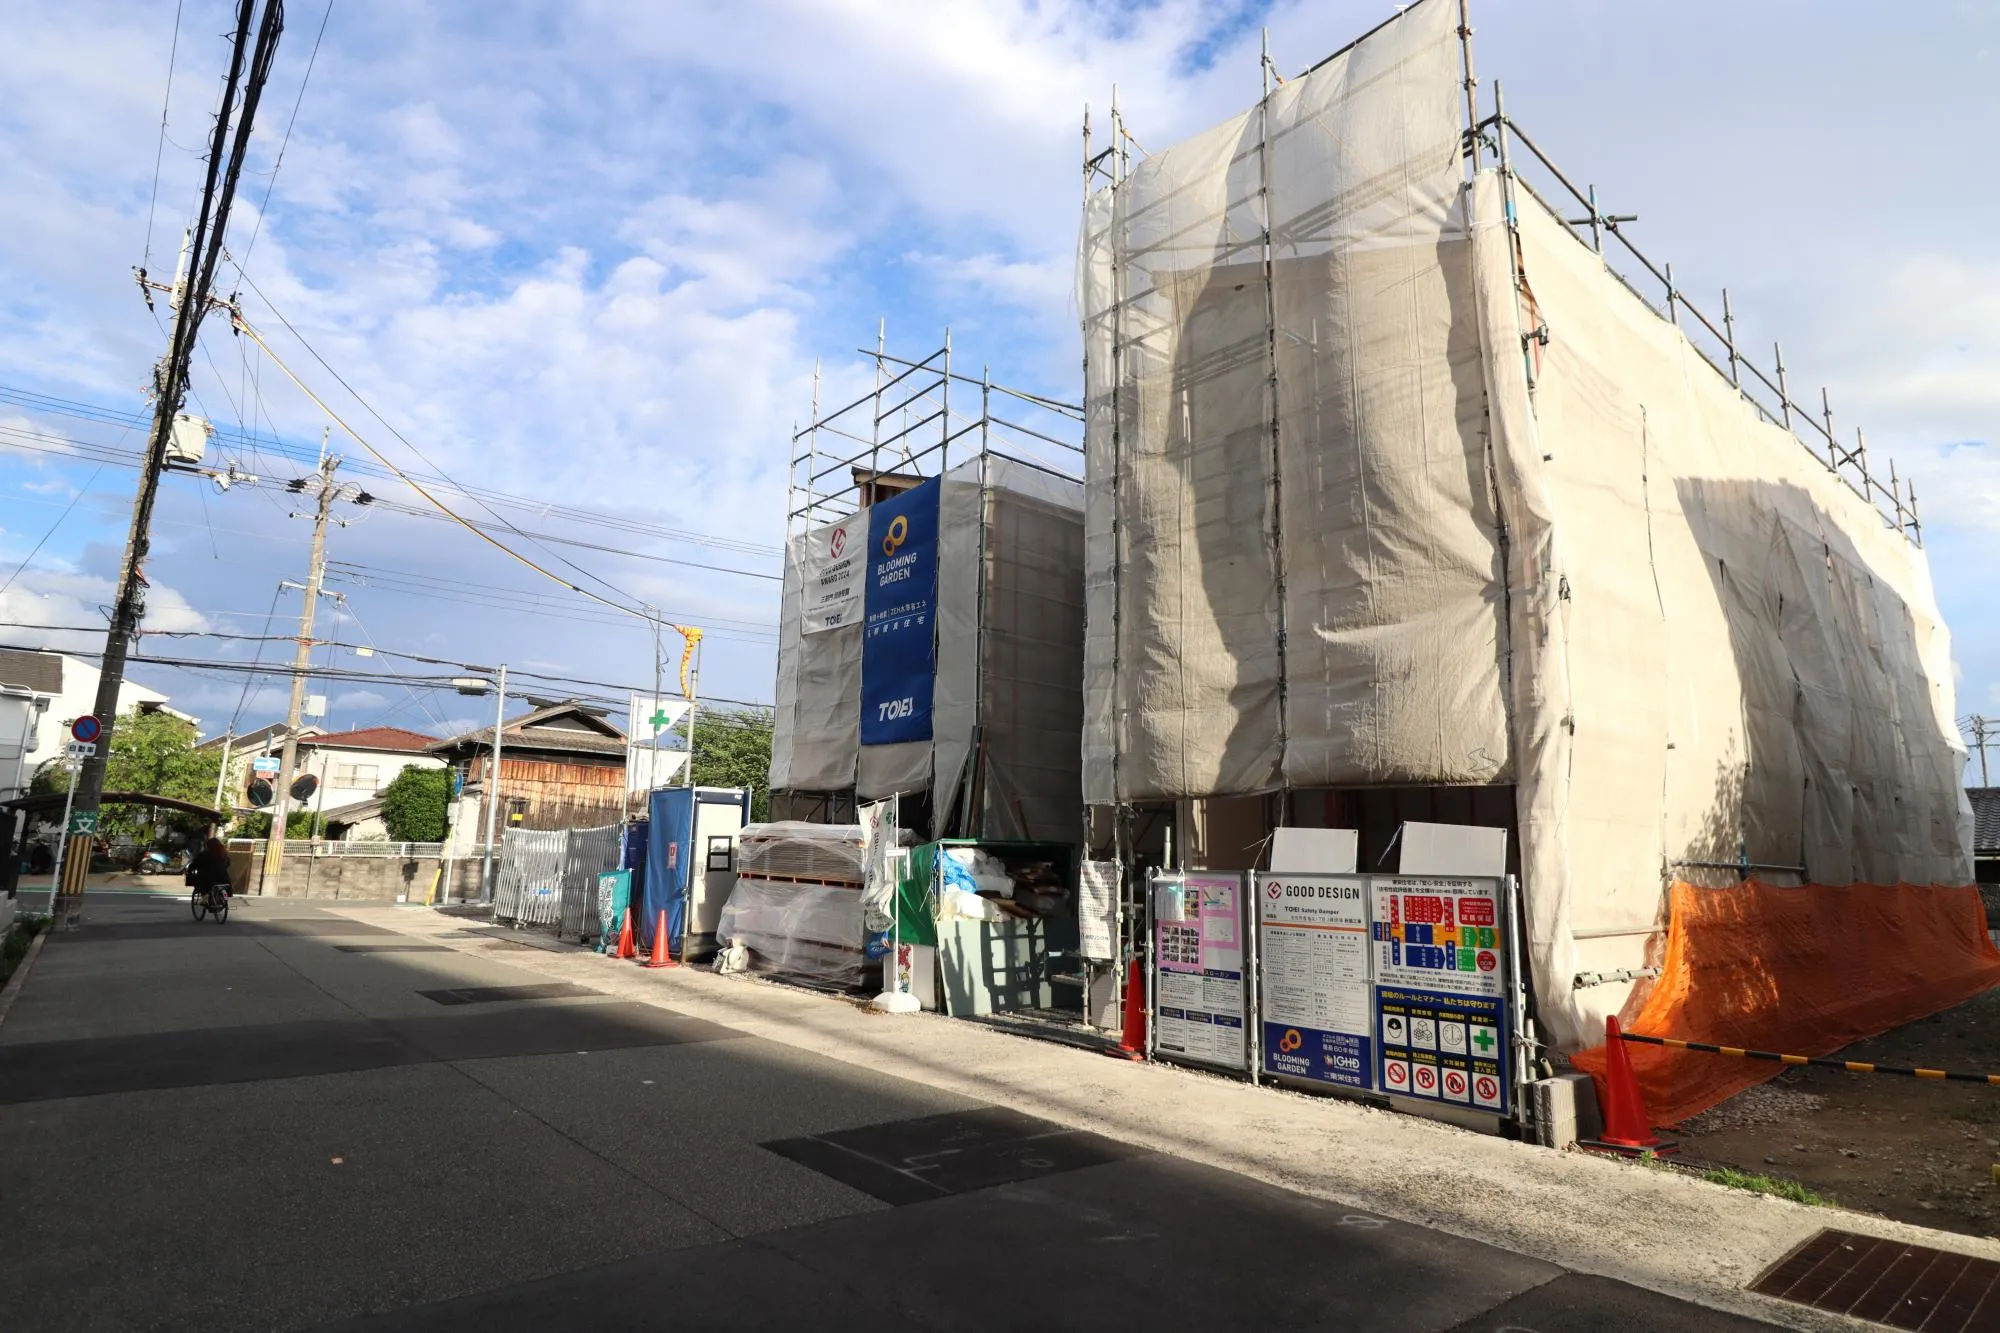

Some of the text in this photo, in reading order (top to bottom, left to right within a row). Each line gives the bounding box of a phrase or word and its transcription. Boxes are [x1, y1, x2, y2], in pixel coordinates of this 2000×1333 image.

[877, 552, 917, 576] BLOOMING
[879, 567, 911, 587] GARDEN
[73, 817, 94, 834] 文
[1286, 885, 1360, 899] GOOD DESIGN
[1273, 1053, 1310, 1066] BLOOMING
[1277, 1062, 1306, 1074] GARDEN
